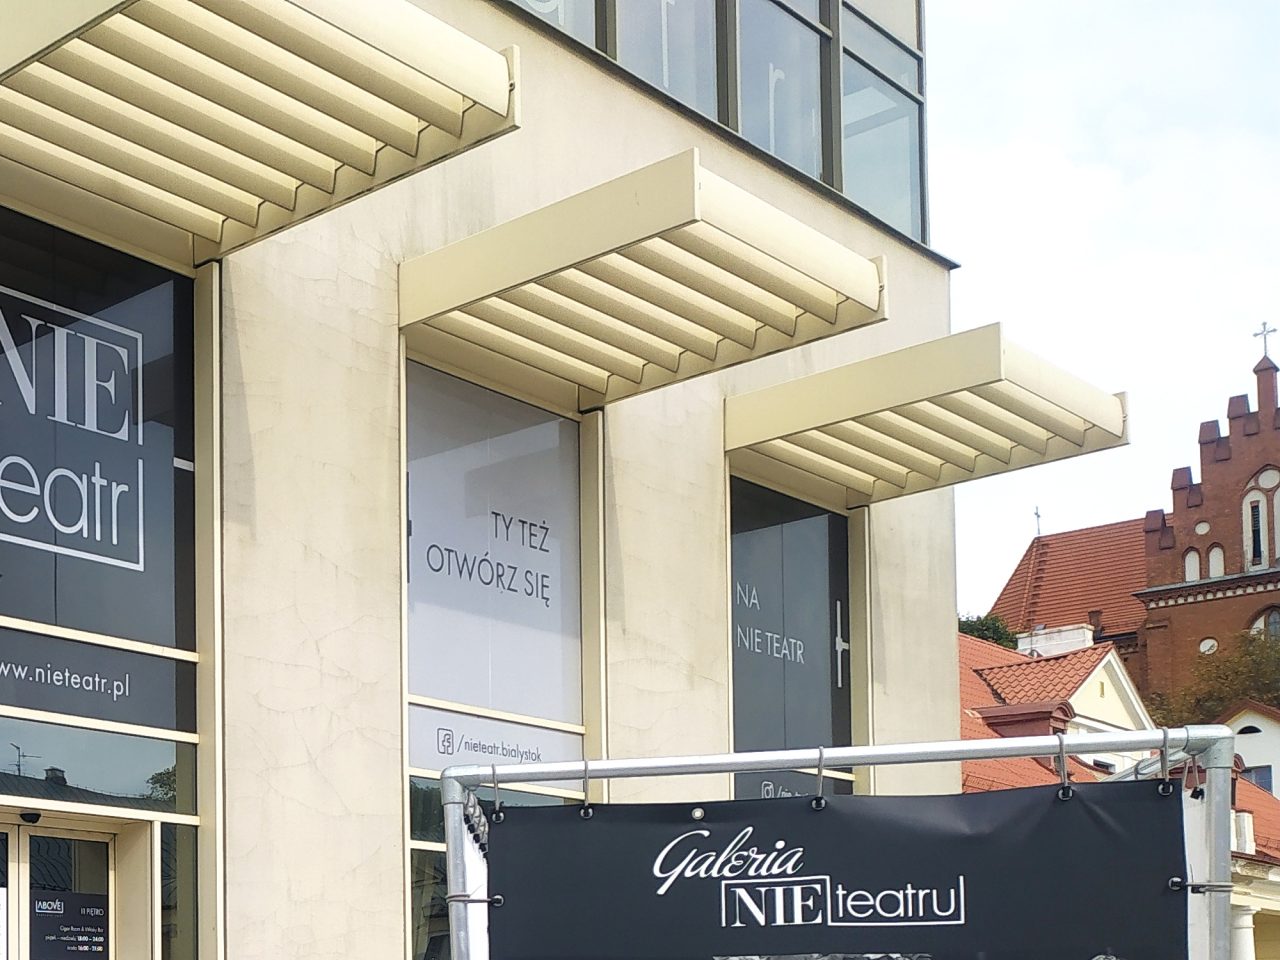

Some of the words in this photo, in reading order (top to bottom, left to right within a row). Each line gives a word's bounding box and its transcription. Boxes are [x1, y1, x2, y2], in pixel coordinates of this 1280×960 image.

[491, 510, 514, 542] TY
[518, 519, 551, 553] TEŻ
[426, 543, 519, 594] OTWÓRZ
[524, 569, 551, 608] SIĘ
[736, 581, 761, 611] NA
[737, 623, 763, 653] NIE
[765, 631, 805, 665] TEATR
[652, 826, 804, 895] Galeria
[37, 899, 62, 910] ABOVE
[729, 883, 824, 928] NIE
[835, 882, 956, 919] teatru
